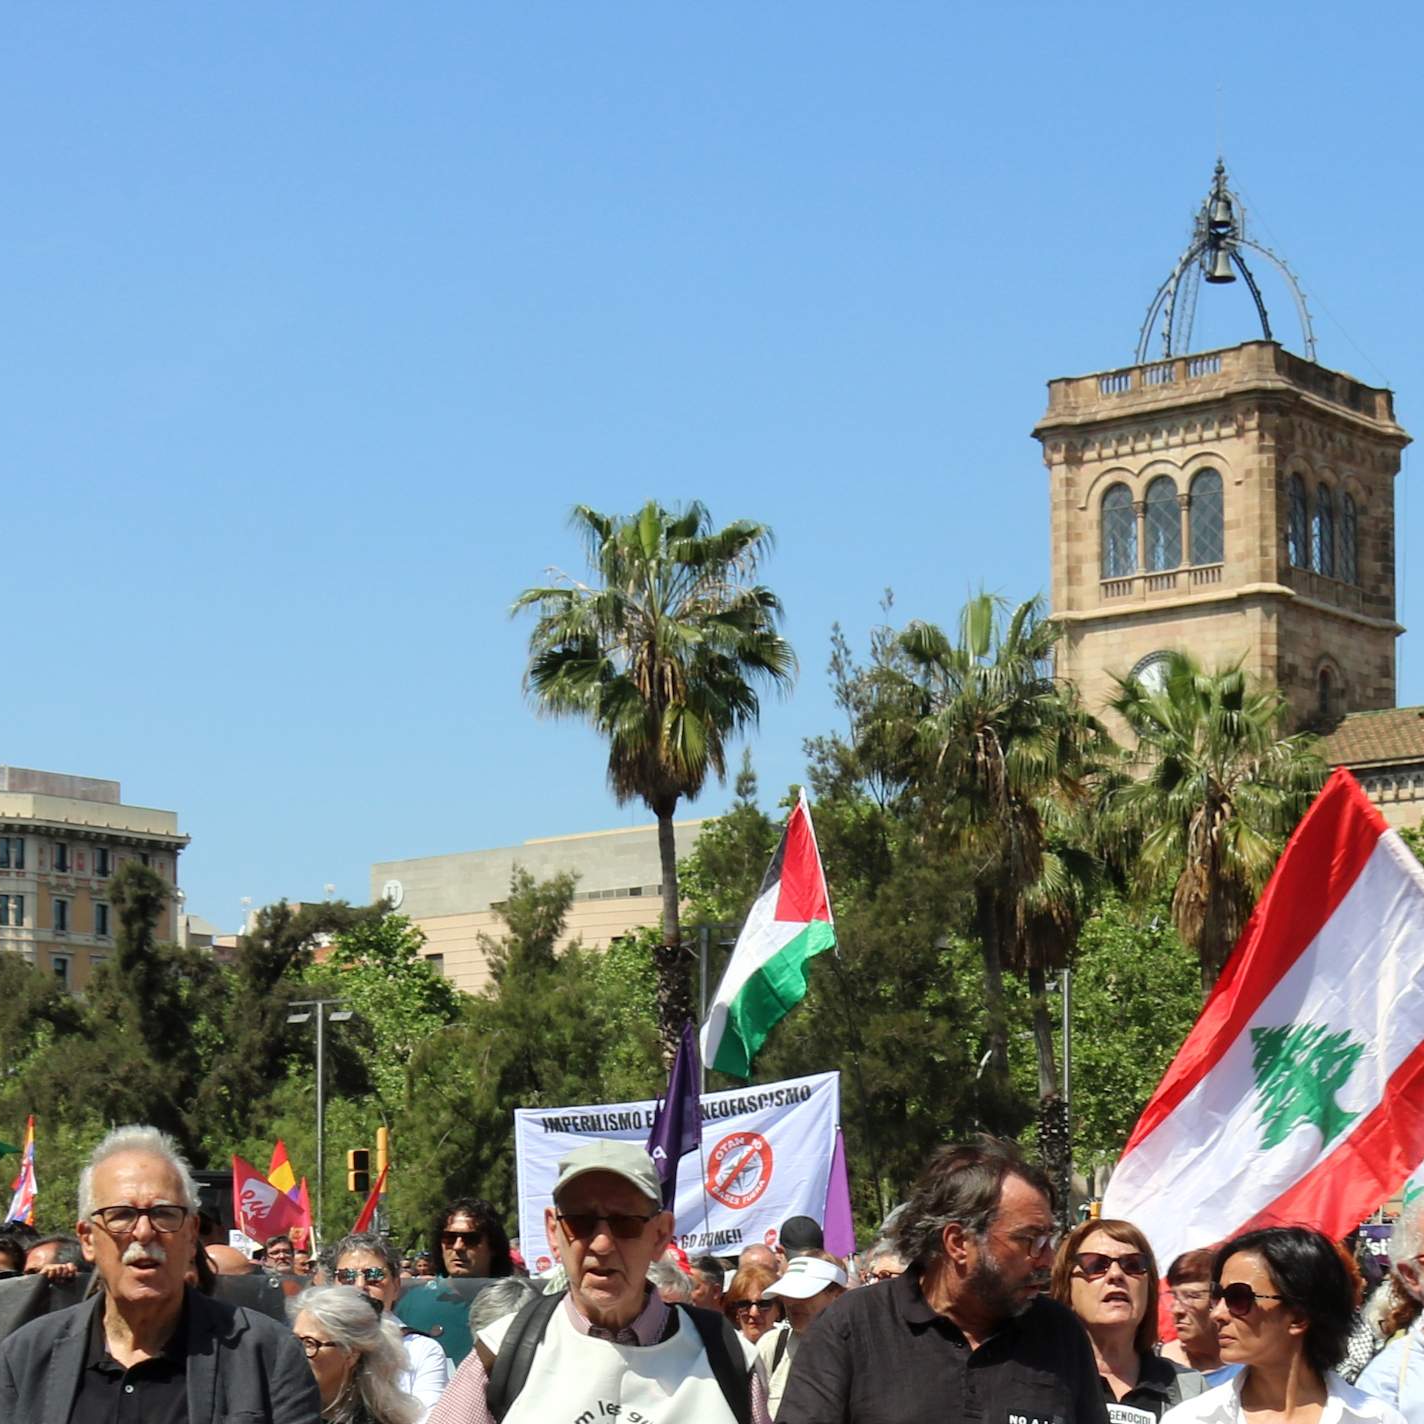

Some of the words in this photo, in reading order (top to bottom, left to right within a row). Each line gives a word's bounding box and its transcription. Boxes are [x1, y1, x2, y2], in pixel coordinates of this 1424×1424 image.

[699, 1085, 811, 1121] NEOFASCISMO
[715, 1137, 744, 1160] OTAN
[598, 1400, 622, 1416] les
